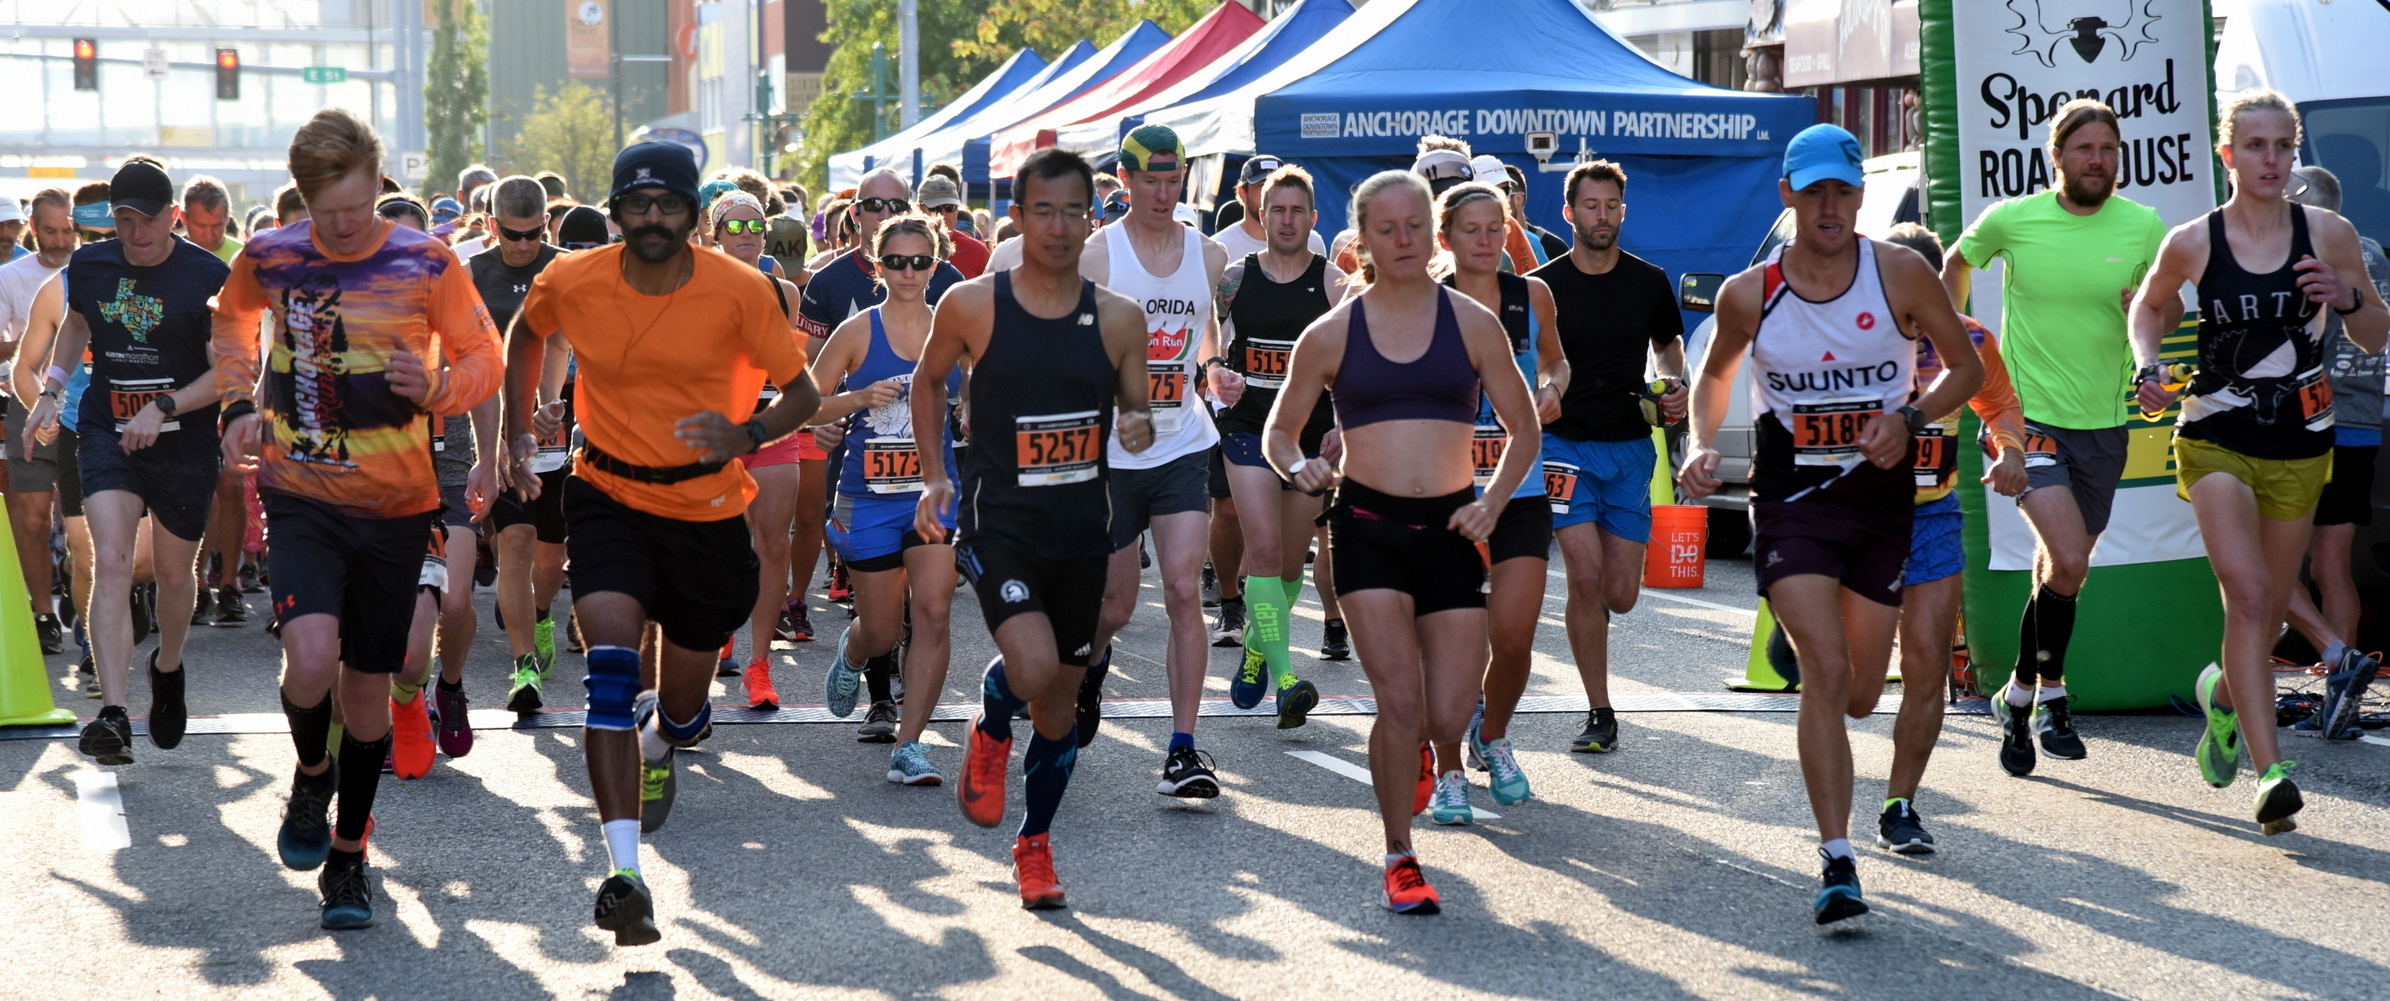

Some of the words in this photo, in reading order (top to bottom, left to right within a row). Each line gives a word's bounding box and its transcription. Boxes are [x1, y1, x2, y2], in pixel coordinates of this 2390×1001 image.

[310, 70, 318, 80] E
[325, 70, 340, 80] St
[1302, 114, 1338, 122] ANCHORAGE
[1343, 110, 1470, 138] ANCHORAGE
[1476, 110, 1606, 136] DOWNTOWN
[1613, 111, 1756, 140] PARTNERSHIP
[772, 240, 801, 258] AK
[1162, 336, 1182, 346] Run
[1766, 360, 1898, 392] SUUNTO
[1150, 374, 1175, 400] 75
[1030, 428, 1090, 464] 5257
[874, 452, 920, 478] 5173
[1546, 473, 1567, 498] 63
[1671, 532, 1699, 542] LET'S
[1671, 544, 1698, 564] DO
[1670, 566, 1700, 578] THIS.
